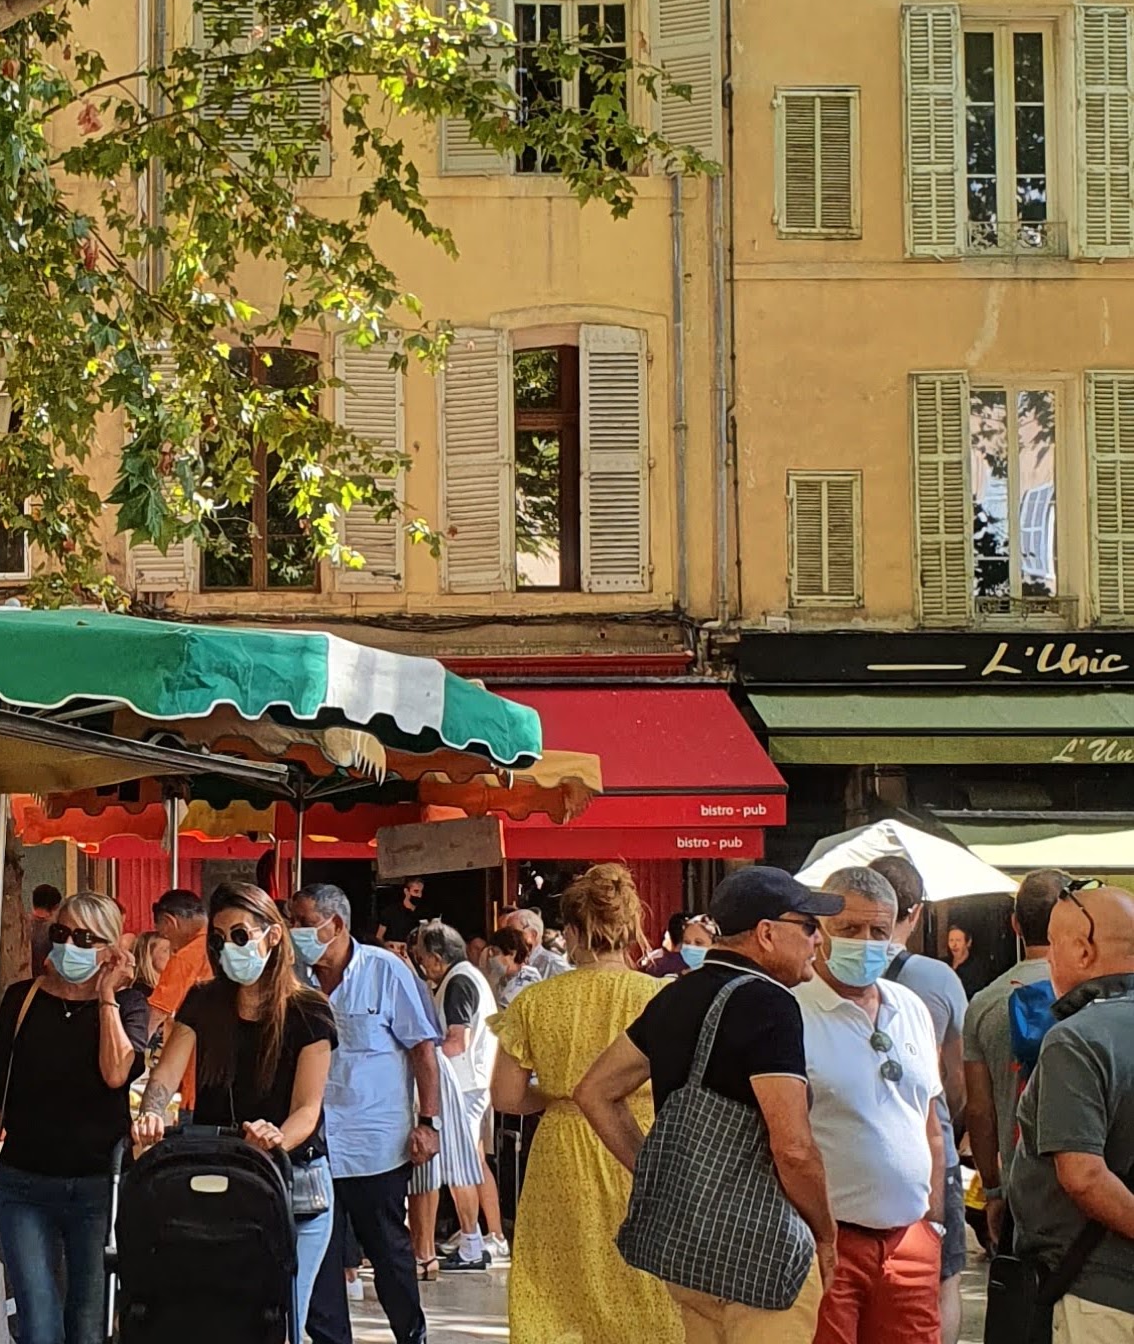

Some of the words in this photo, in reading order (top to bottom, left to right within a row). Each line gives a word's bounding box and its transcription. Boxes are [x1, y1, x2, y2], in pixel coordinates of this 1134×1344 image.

[700, 805, 734, 816] bistro
[743, 803, 767, 818] pub
[677, 836, 710, 848] bistro
[719, 836, 743, 850] pub
